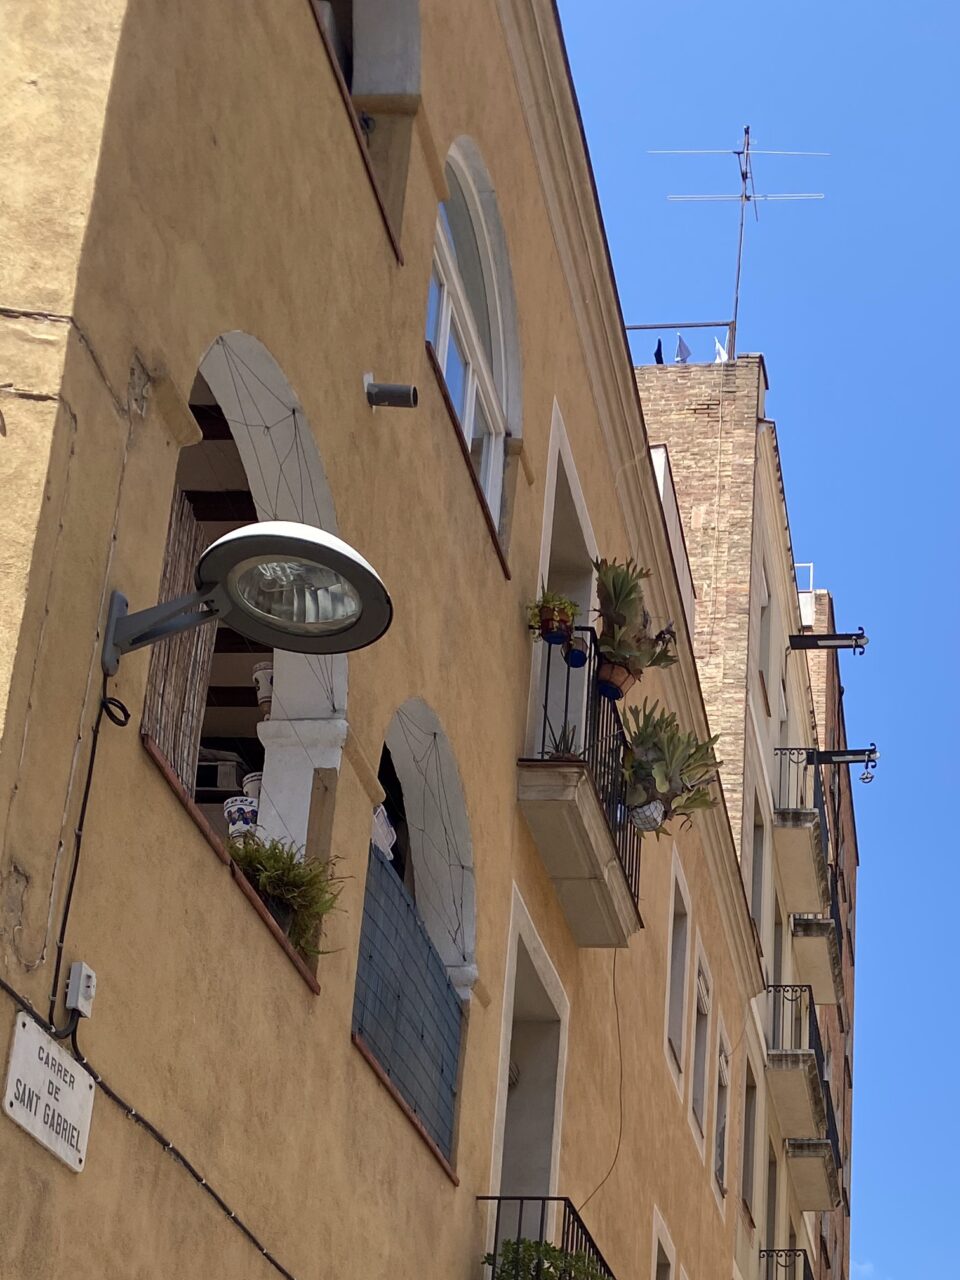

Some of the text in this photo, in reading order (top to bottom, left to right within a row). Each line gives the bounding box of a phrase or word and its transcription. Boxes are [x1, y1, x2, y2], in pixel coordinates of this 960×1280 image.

[37, 1046, 76, 1090] CARRER
[47, 1079, 61, 1102] DE
[14, 1078, 81, 1154] SANT GABRIEL
